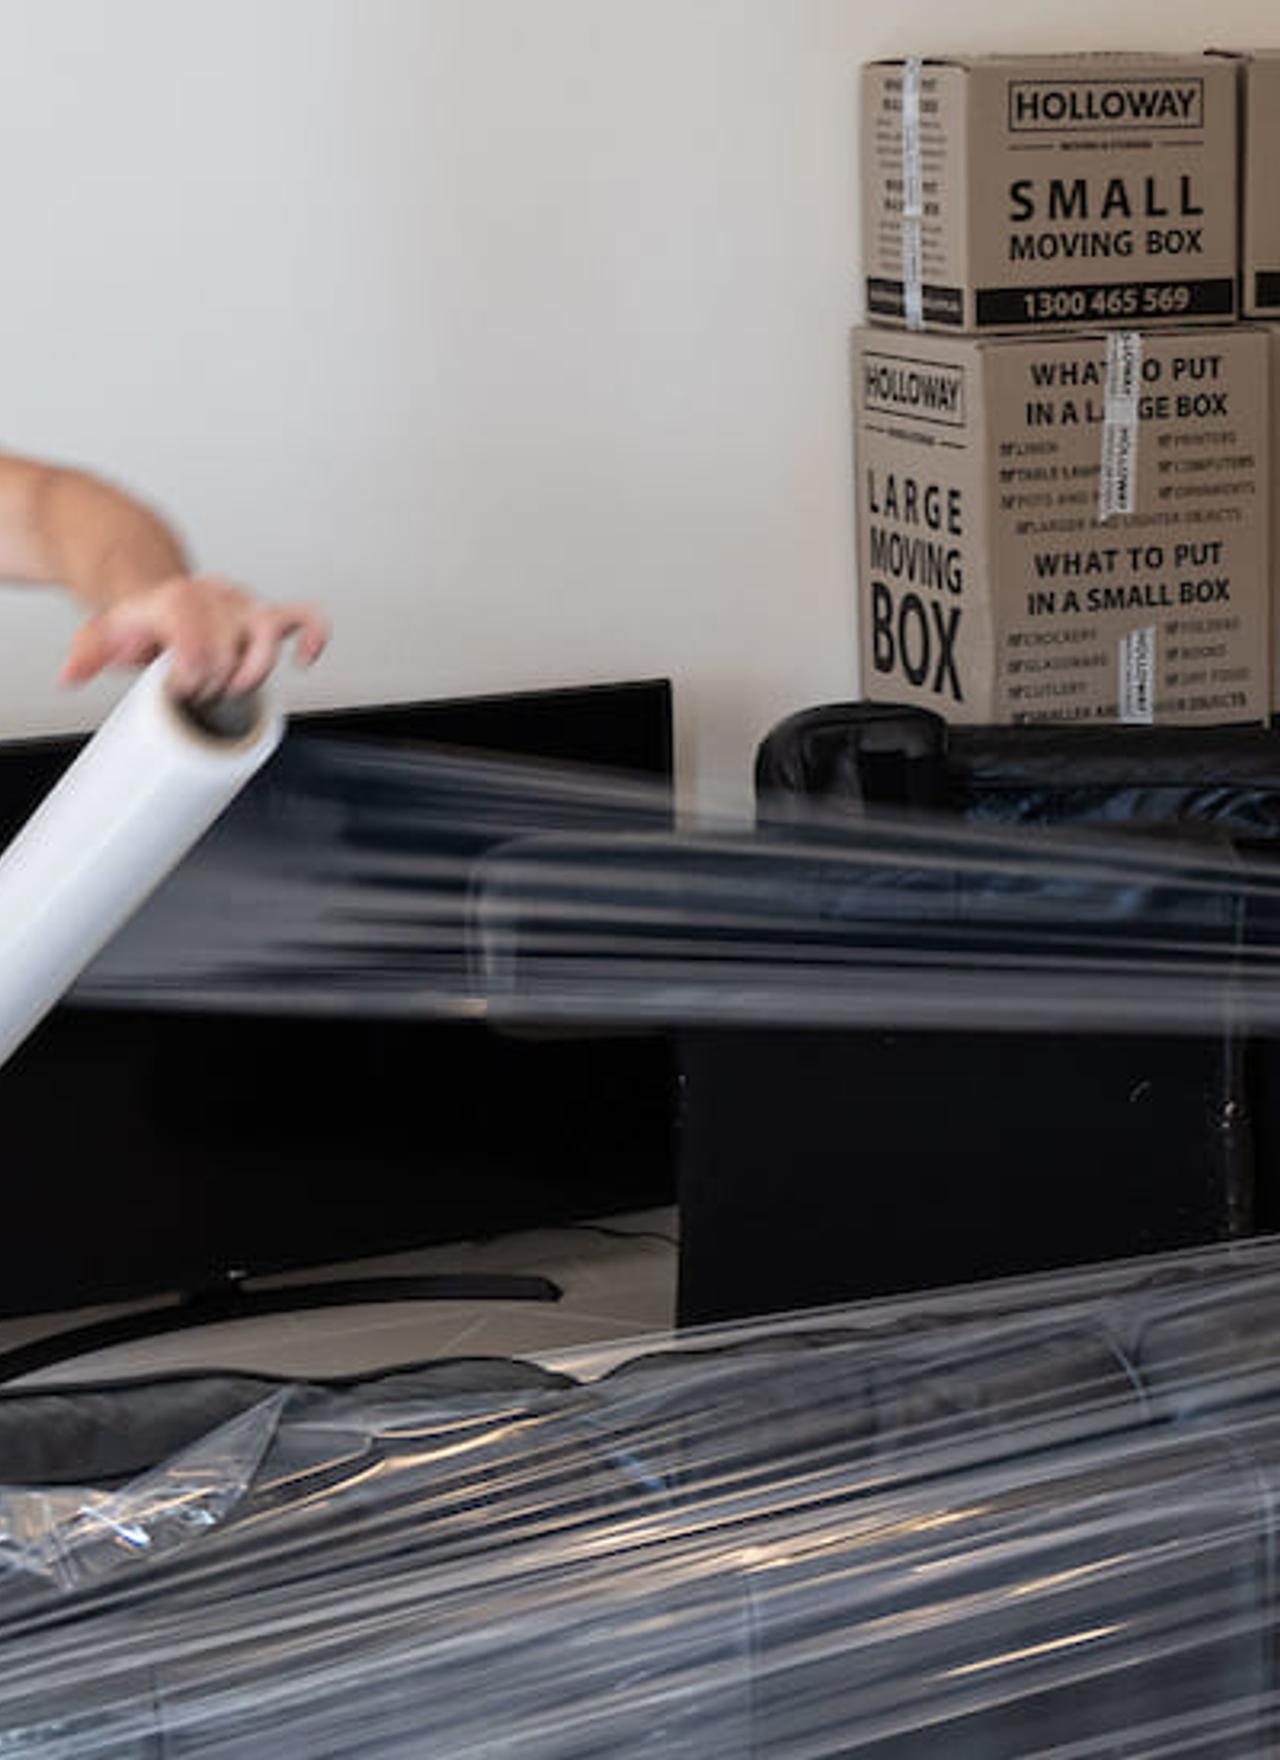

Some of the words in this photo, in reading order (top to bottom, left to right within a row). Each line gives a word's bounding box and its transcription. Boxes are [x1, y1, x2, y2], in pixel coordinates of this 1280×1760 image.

[1017, 89, 1196, 121] HOLLOWAY
[1009, 176, 1204, 222] SMALL
[1009, 230, 1133, 260] MOVING
[1146, 229, 1204, 256] BOX
[1023, 291, 1084, 318] 1300
[1091, 289, 1137, 315] 465
[1144, 286, 1190, 312] 569
[1141, 358, 1161, 382] O
[1172, 355, 1223, 381] PUT
[865, 365, 960, 412] HOLLOWAY
[1026, 401, 1053, 426] IN
[1061, 401, 1079, 425] A
[1086, 395, 1170, 423] LGE
[1175, 393, 1229, 418] BOX
[867, 468, 962, 537] LARGE
[870, 525, 962, 596] MOVING
[1034, 549, 1118, 578] WHAT
[1127, 547, 1164, 571] TO
[1174, 541, 1224, 567] PUT
[1027, 592, 1055, 616] IN
[1062, 590, 1080, 613] A
[1086, 584, 1173, 613] SMALL
[1179, 578, 1230, 604] BOX
[871, 580, 964, 703] BOX
